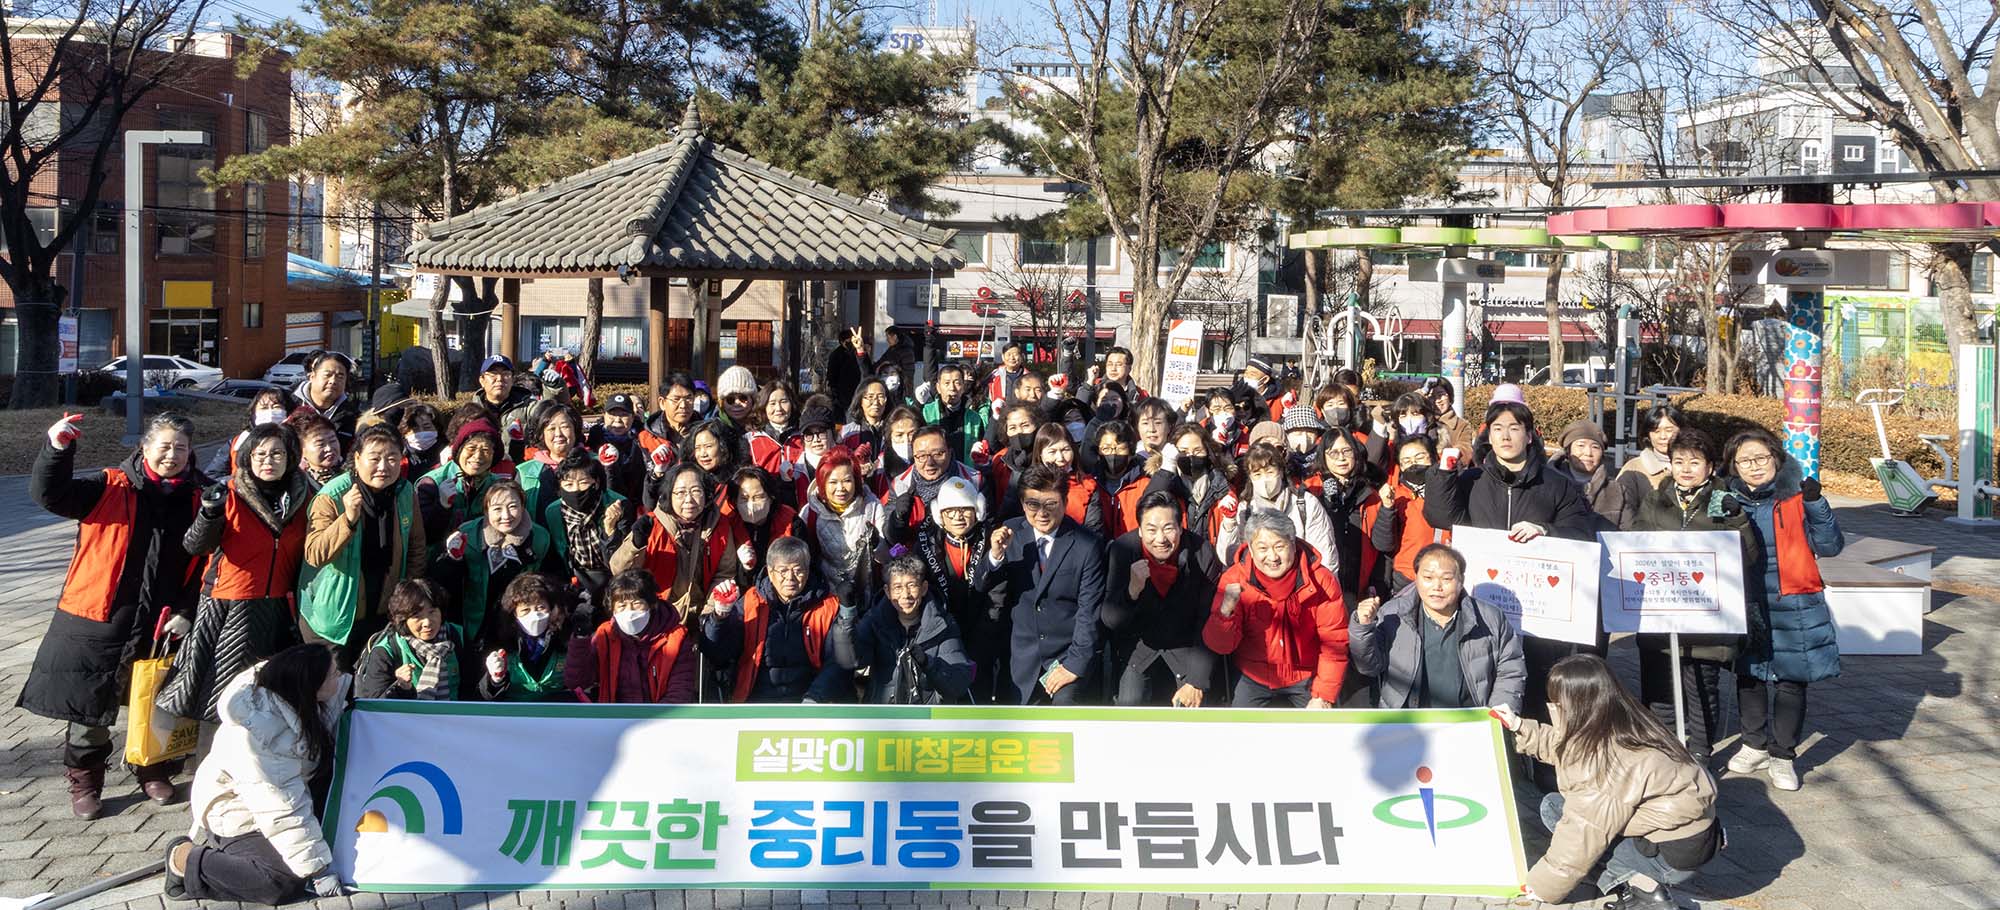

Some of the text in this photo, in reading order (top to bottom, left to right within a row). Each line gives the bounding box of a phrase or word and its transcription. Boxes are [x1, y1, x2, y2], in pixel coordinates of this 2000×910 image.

[1647, 571, 1691, 586] 중리동
[753, 737, 1062, 774] 설맞이 대청결운동
[499, 798, 1344, 870] 깨끗한 중리동을 만듭시다
